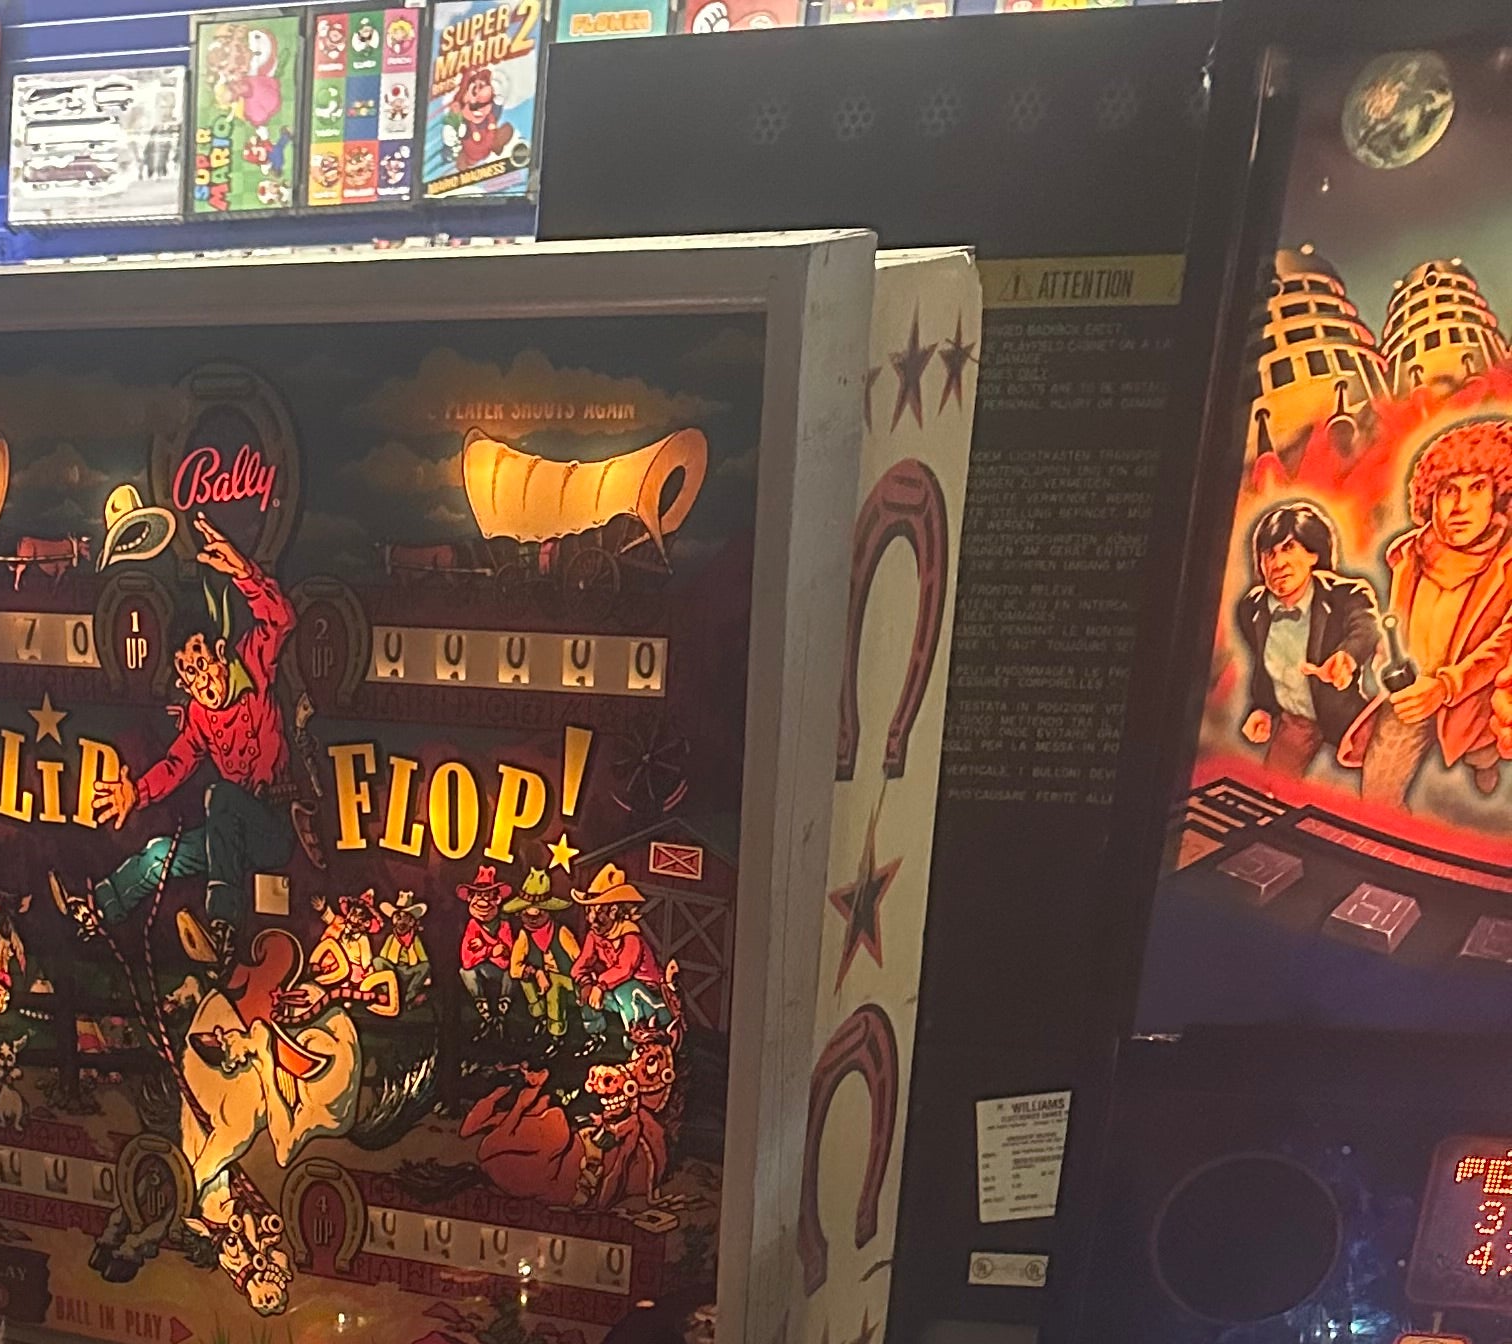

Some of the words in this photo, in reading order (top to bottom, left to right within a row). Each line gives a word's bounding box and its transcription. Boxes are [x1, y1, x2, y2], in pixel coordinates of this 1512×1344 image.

[442, 4, 510, 51] SUPER
[510, 0, 541, 53] 2
[435, 33, 512, 82] MARIO
[194, 128, 211, 201] SUPER
[209, 114, 232, 211] MARIO
[1039, 270, 1134, 298] ATTENTION
[444, 402, 504, 420] PLAYER
[511, 402, 576, 420] SHOOTS
[584, 402, 635, 420] AGAIN
[173, 444, 276, 512] Bally
[130, 611, 141, 633] 1
[314, 618, 329, 641] 2
[125, 636, 148, 671] UP
[311, 645, 334, 680] UP
[328, 725, 591, 873] FLOP!
[1011, 1099, 1065, 1114] WILLIAMS
[146, 1188, 168, 1217] UP
[313, 1217, 335, 1246] UP
[55, 1294, 89, 1323] BALL
[98, 1303, 116, 1331] IN
[124, 1309, 162, 1341] PLAY
